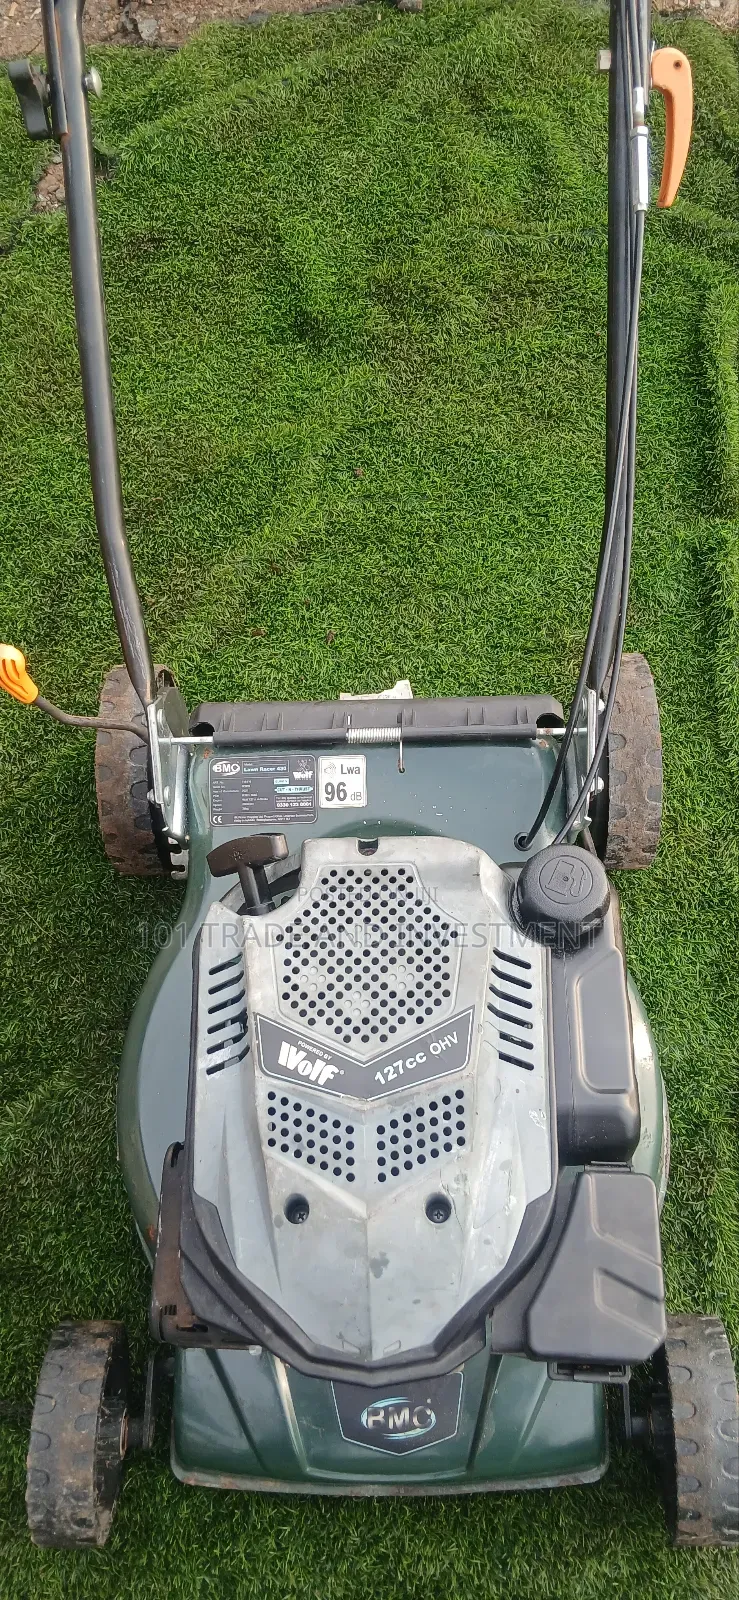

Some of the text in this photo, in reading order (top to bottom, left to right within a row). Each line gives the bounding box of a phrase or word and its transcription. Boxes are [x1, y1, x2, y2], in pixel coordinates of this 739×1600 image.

[340, 763, 361, 775] Lwa
[324, 781, 348, 802] 96
[350, 791, 363, 801] dB
[297, 1040, 333, 1061] POWERED BY
[374, 1031, 459, 1085] 127cc OHV
[277, 1040, 340, 1086] Wolf
